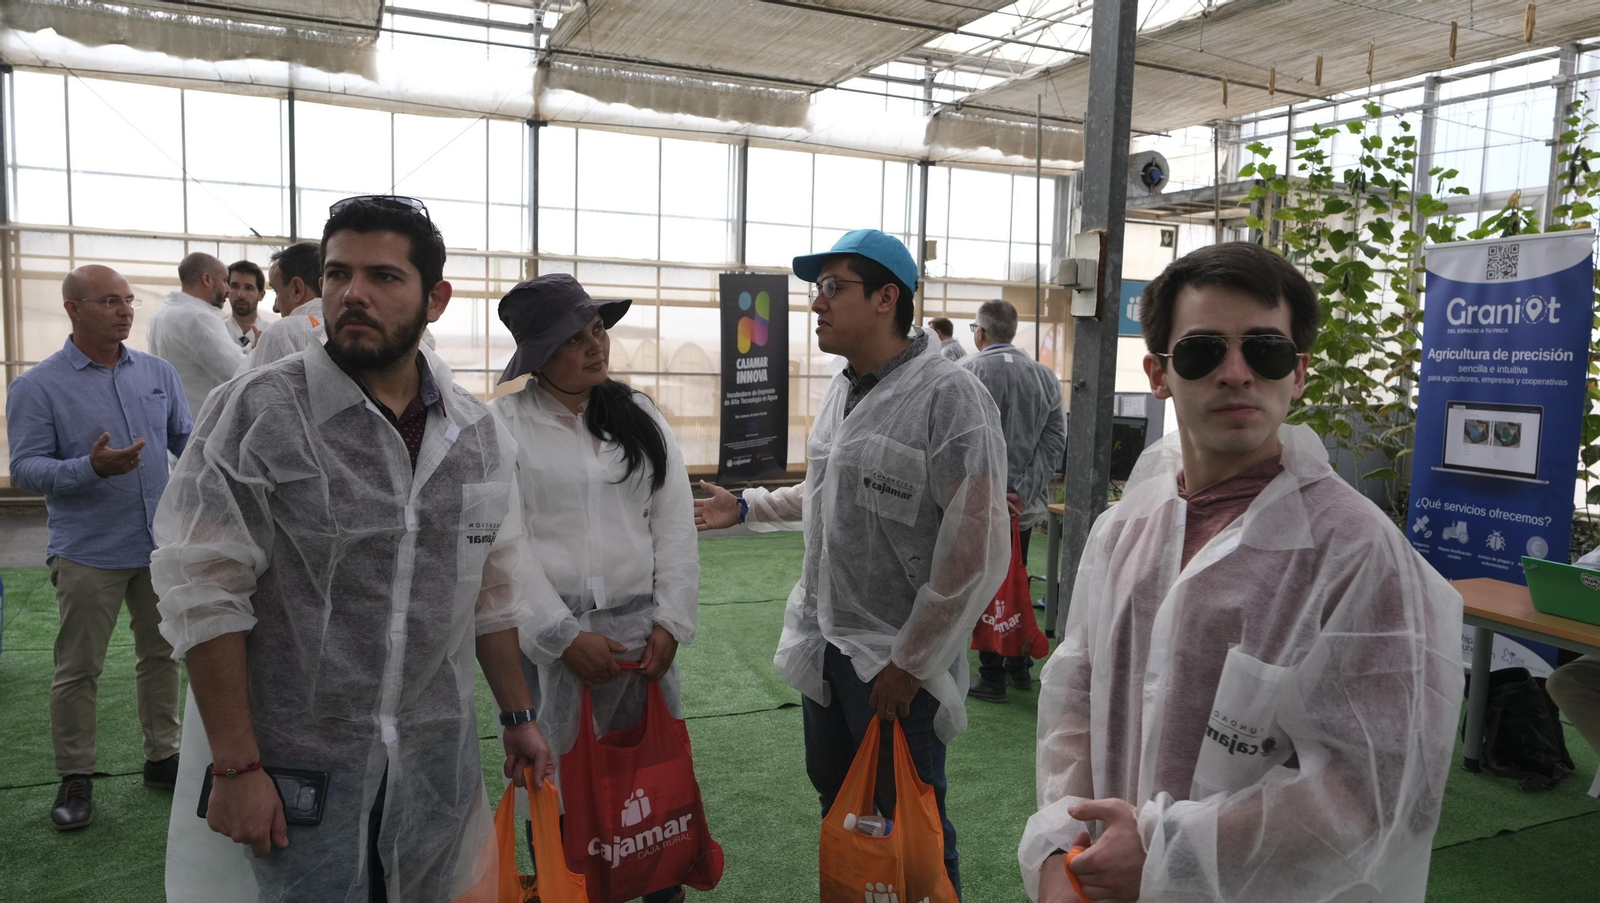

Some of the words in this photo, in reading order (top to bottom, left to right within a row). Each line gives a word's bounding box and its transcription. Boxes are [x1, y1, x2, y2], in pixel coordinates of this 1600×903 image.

[736, 356, 768, 370] CAJAMAR
[1428, 348, 1490, 362] Agricultura
[1493, 349, 1508, 360] de
[1512, 348, 1573, 363] precisión
[736, 369, 768, 384] INNOVA
[1458, 365, 1488, 373] sencilla
[1497, 365, 1528, 374] intuitiva
[1442, 375, 1480, 383] agricultores,
[1522, 378, 1568, 386] cooperativas
[872, 482, 913, 500] cajamar
[1416, 497, 1441, 509] ¿Qué
[1444, 502, 1487, 517] servicios
[1489, 508, 1552, 527] ofrecemos?
[587, 813, 692, 869] cajamar
[637, 845, 661, 860] CAJA
[663, 833, 693, 849] RURAL
